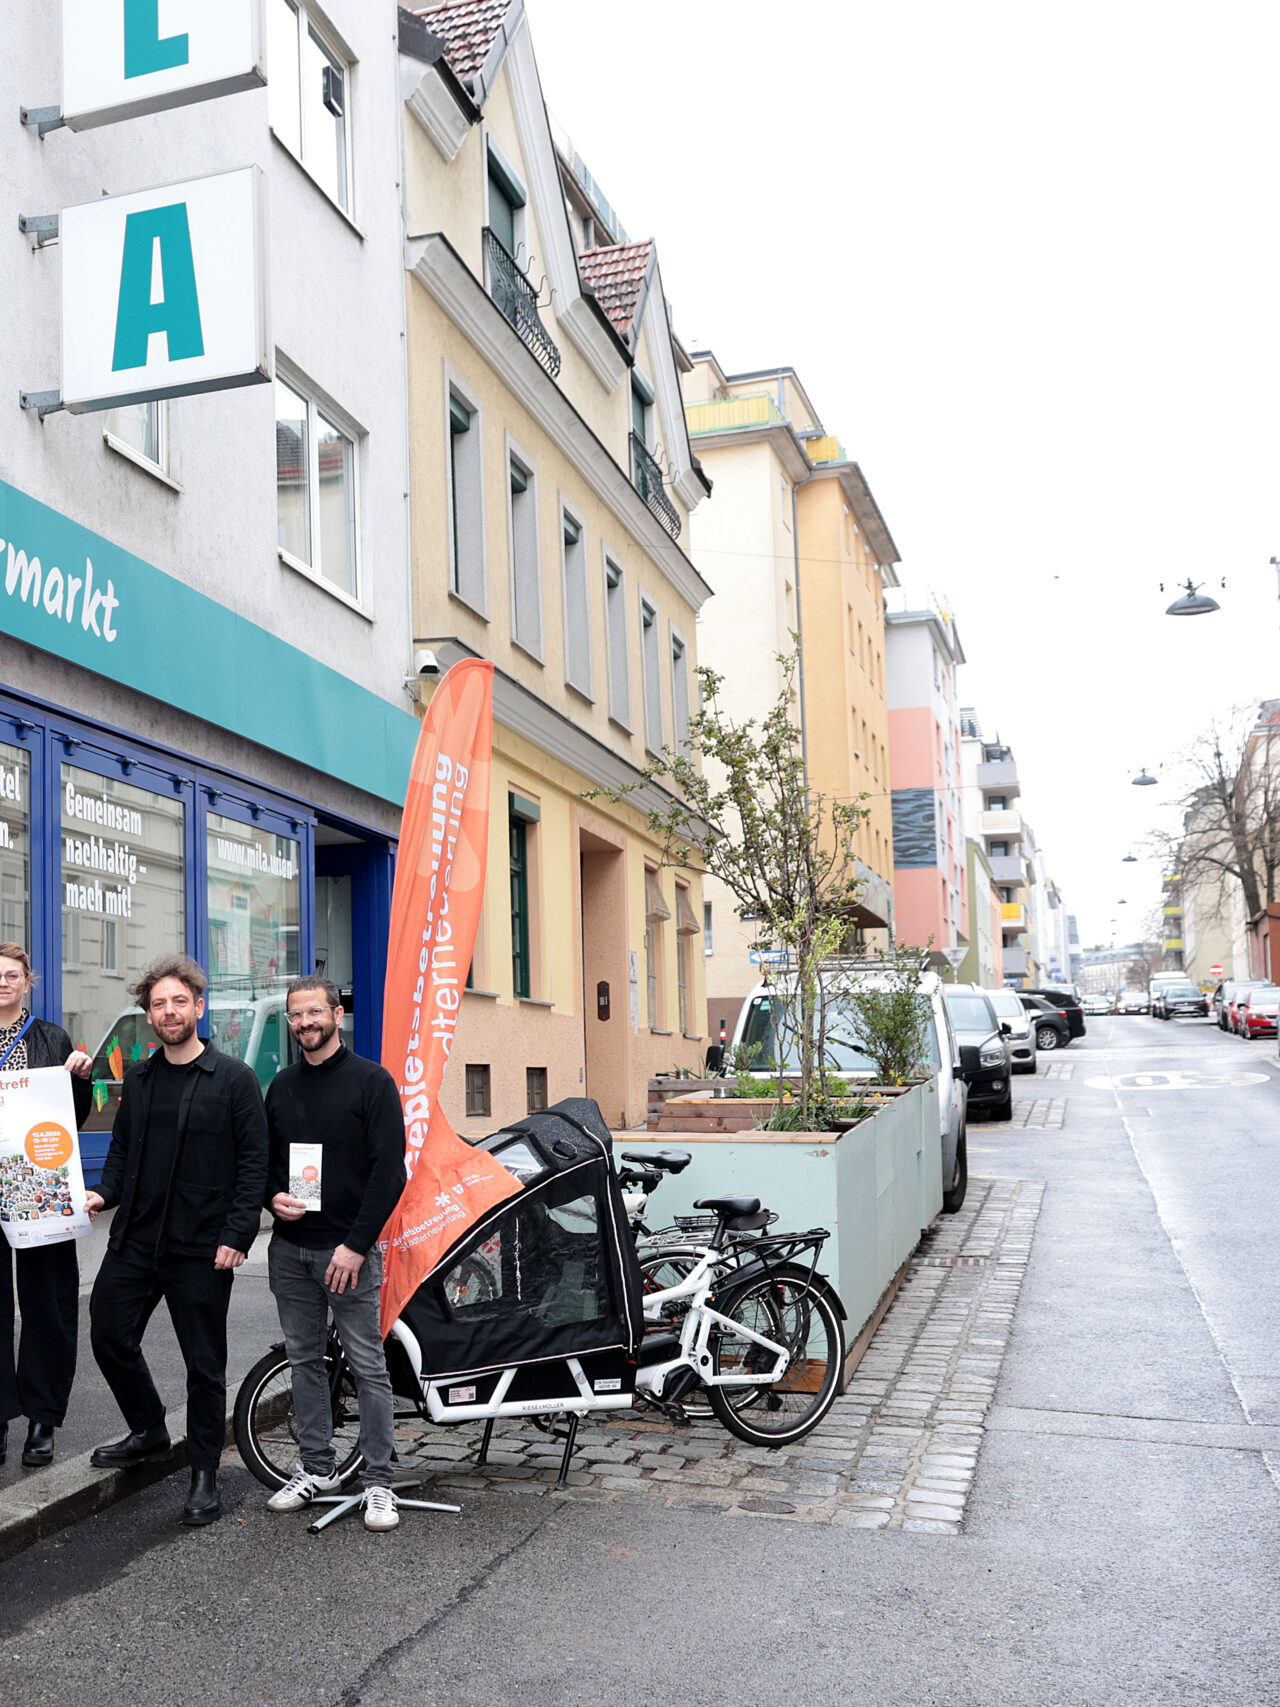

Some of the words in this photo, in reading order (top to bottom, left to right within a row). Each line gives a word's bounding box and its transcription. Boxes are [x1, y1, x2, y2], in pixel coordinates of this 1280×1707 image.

[111, 202, 205, 372] A
[65, 782, 142, 836] Gemeinsam
[65, 836, 137, 885] nachhaltig
[217, 838, 293, 880] www.mila.wien
[65, 880, 105, 914] mach
[105, 886, 132, 919] mit!
[400, 1210, 466, 1252] Stadterneuerung
